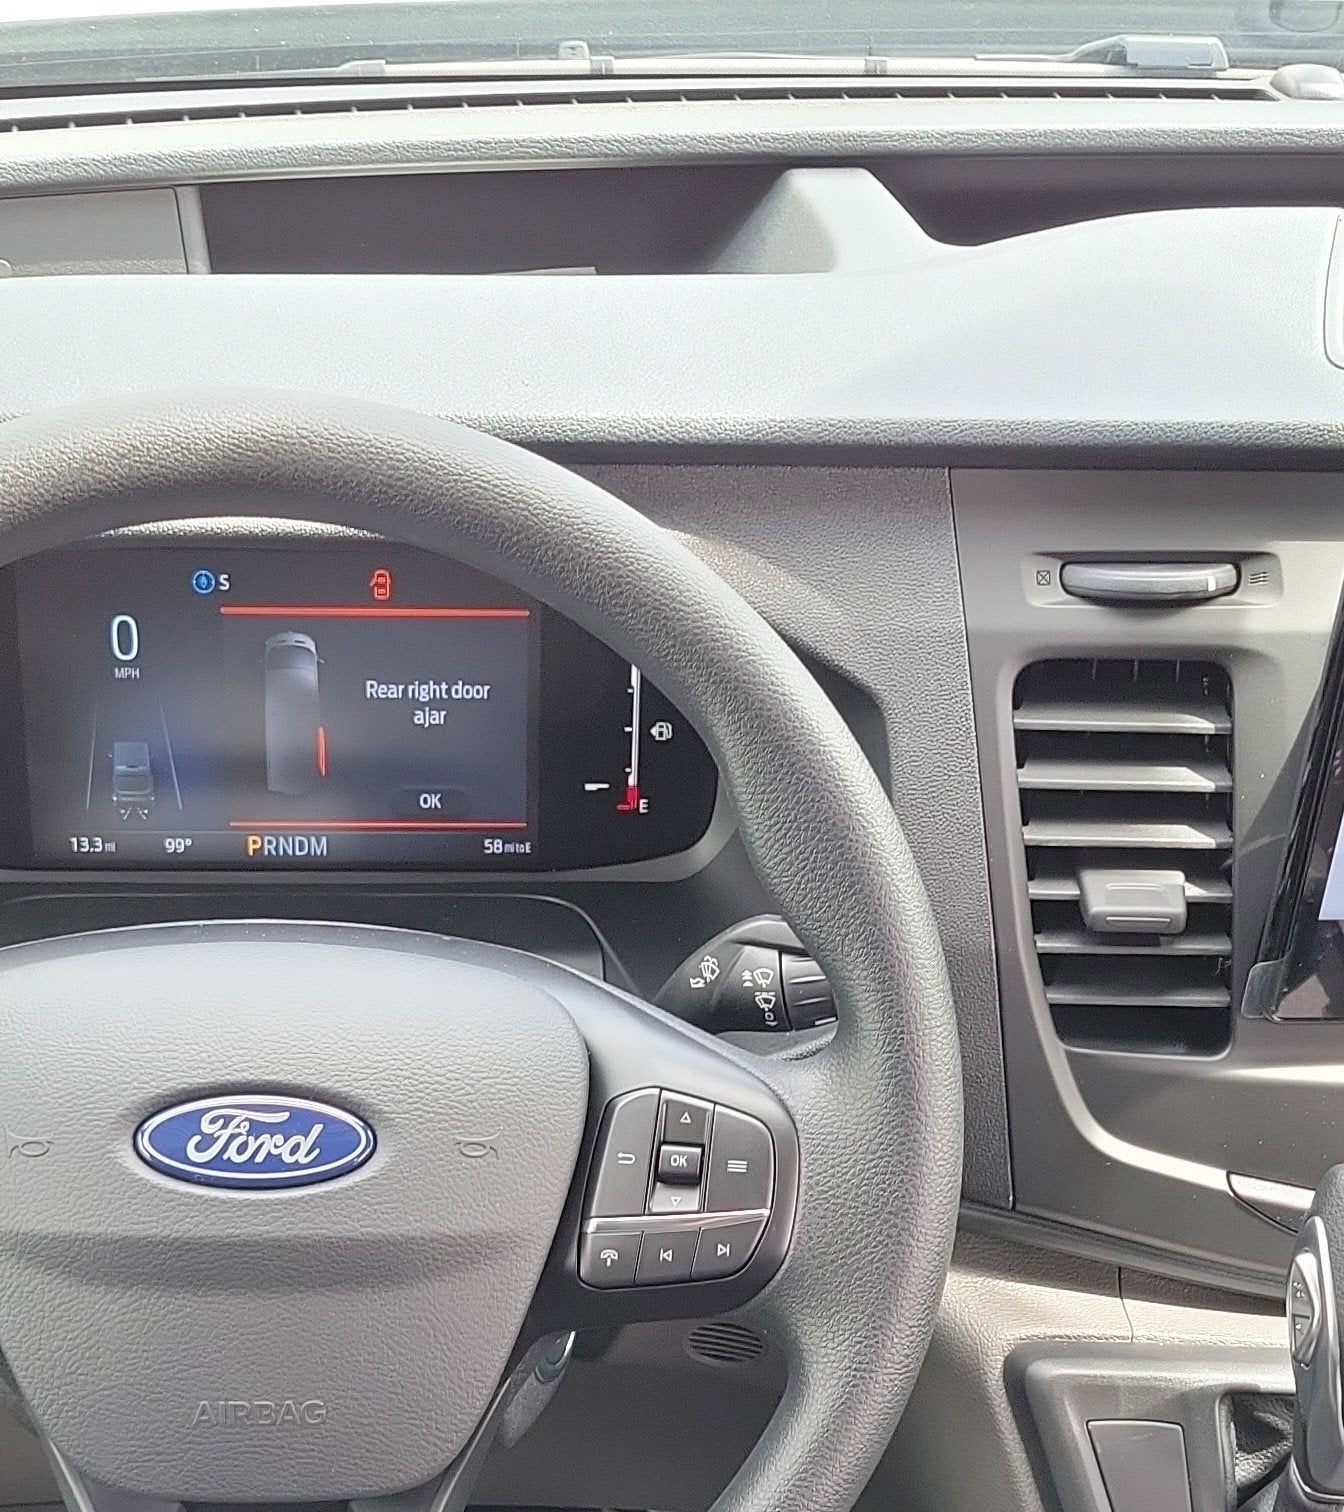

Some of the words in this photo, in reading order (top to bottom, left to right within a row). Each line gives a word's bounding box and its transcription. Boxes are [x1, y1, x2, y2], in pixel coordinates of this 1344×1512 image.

[111, 614, 140, 661] 0
[114, 667, 140, 680] MPH
[365, 680, 405, 699] Rear
[408, 681, 449, 702] right
[451, 680, 491, 699] door
[413, 706, 447, 728] ajar
[419, 793, 442, 809] OK
[639, 798, 649, 813] E
[70, 836, 103, 853] 13.3
[484, 838, 503, 854] 58
[186, 1108, 325, 1166] Ford
[670, 1154, 687, 1168] OK
[192, 1399, 328, 1427] AIRBAG
